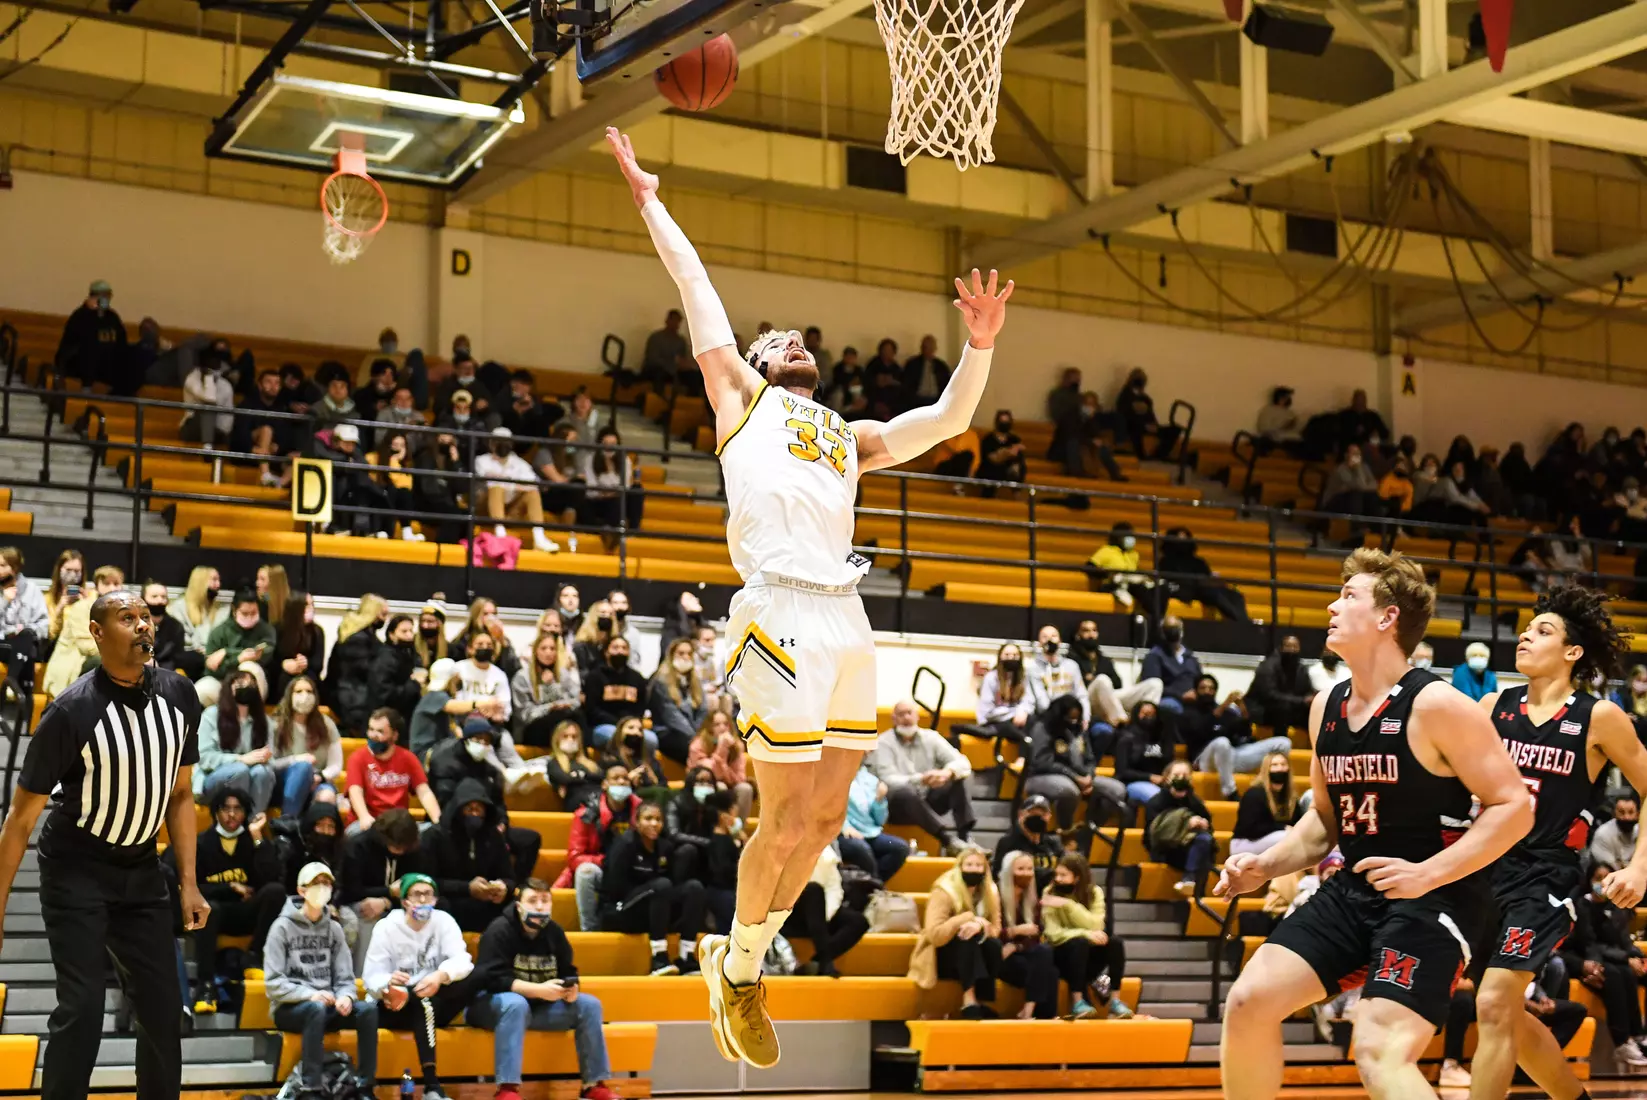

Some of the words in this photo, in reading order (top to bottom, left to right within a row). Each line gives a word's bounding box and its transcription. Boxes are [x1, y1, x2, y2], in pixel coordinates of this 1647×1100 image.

[452, 248, 471, 276] D
[1402, 372, 1416, 395] A
[297, 463, 327, 515] D
[1501, 738, 1576, 776] ANSFIELD
[1340, 792, 1379, 835] 24
[1500, 926, 1536, 959] M
[1374, 947, 1421, 990] M
